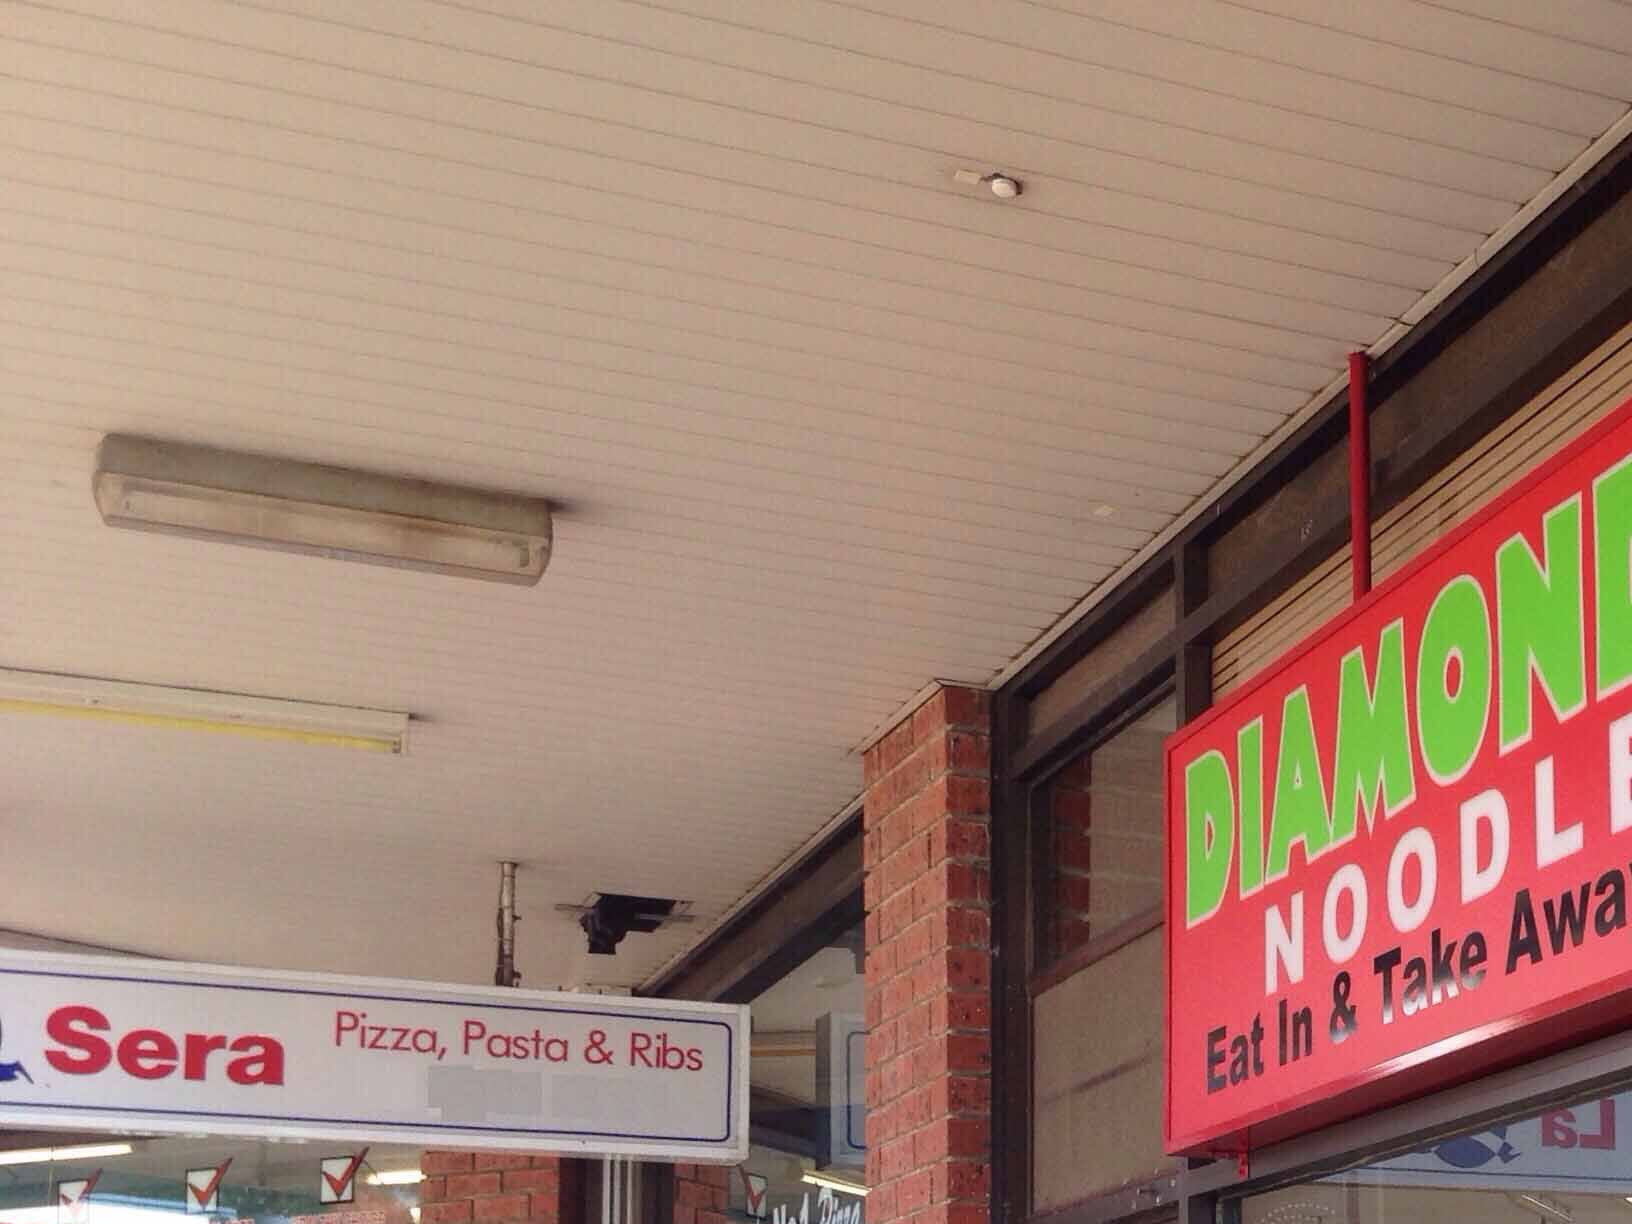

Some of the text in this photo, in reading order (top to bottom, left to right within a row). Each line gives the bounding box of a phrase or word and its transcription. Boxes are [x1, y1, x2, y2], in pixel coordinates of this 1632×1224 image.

[44, 1005, 704, 1087] Sera Pizza, Pasta & Ribs
[1206, 1002, 1265, 1095] Eat
[1277, 996, 1314, 1059] In
[1328, 971, 1358, 1043] &
[1373, 927, 1489, 1025] Take
